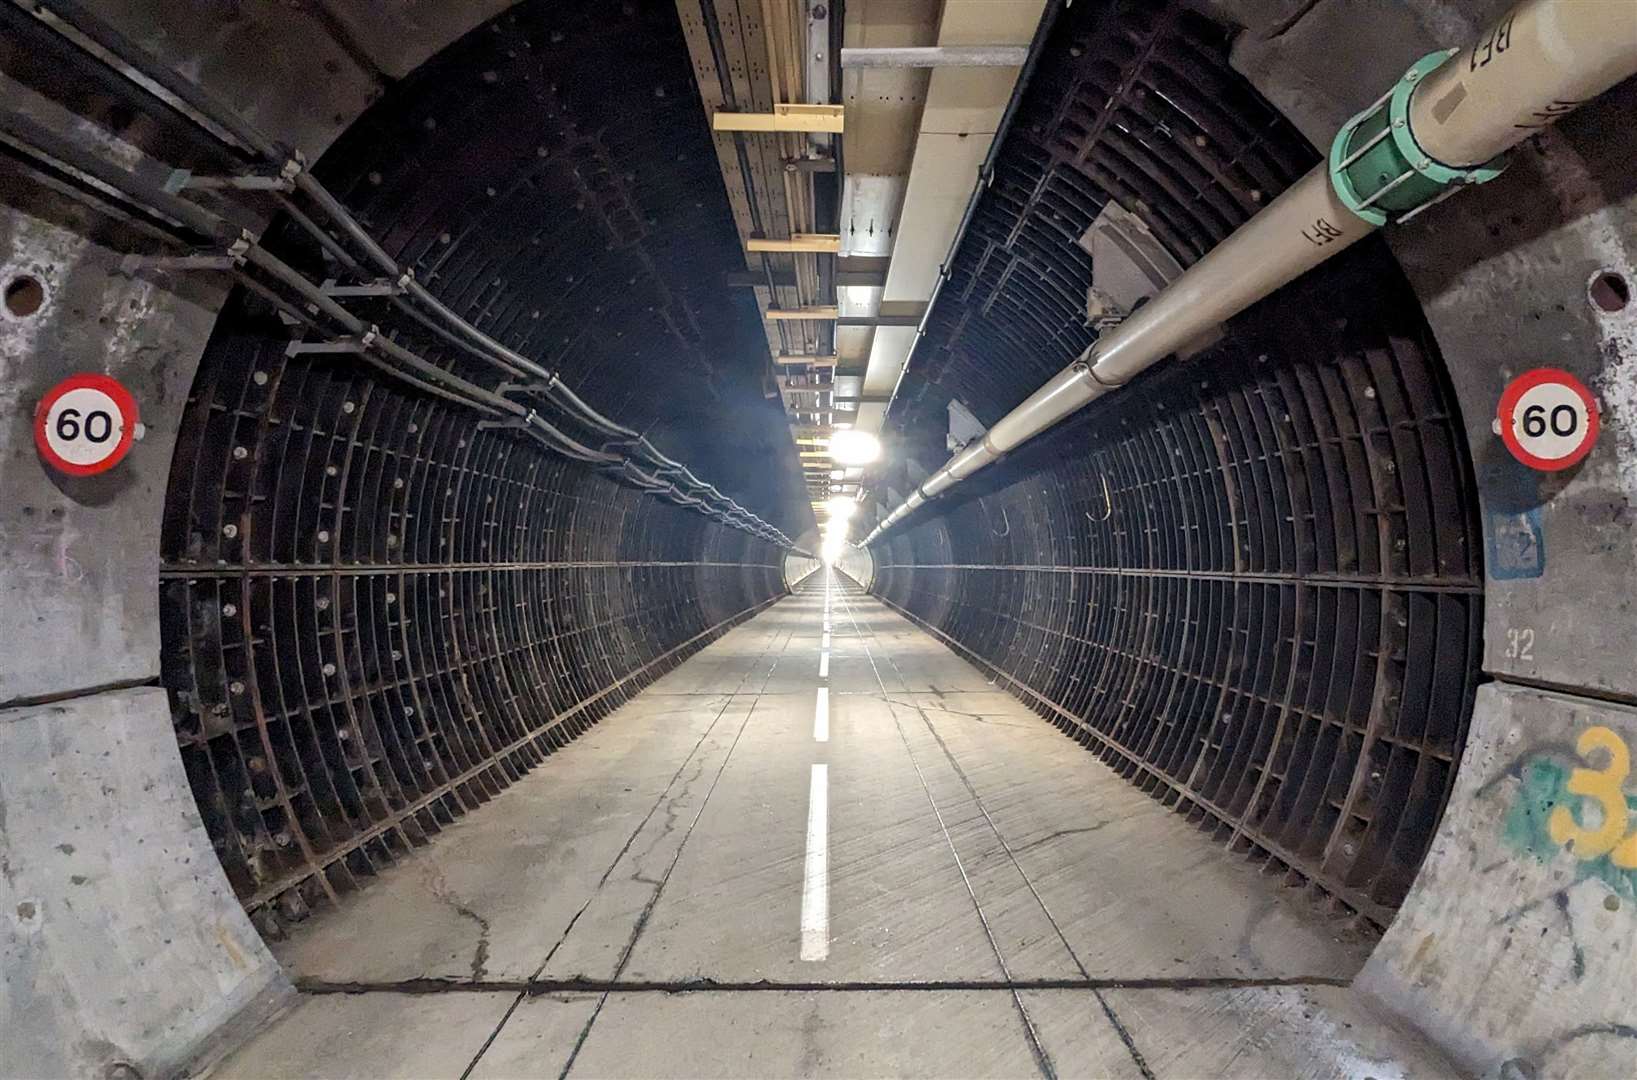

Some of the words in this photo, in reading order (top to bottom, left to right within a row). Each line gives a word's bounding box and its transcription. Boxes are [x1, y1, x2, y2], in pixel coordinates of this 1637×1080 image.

[56, 408, 113, 443] 60
[1522, 404, 1577, 437] 60
[1505, 628, 1535, 661] 32
